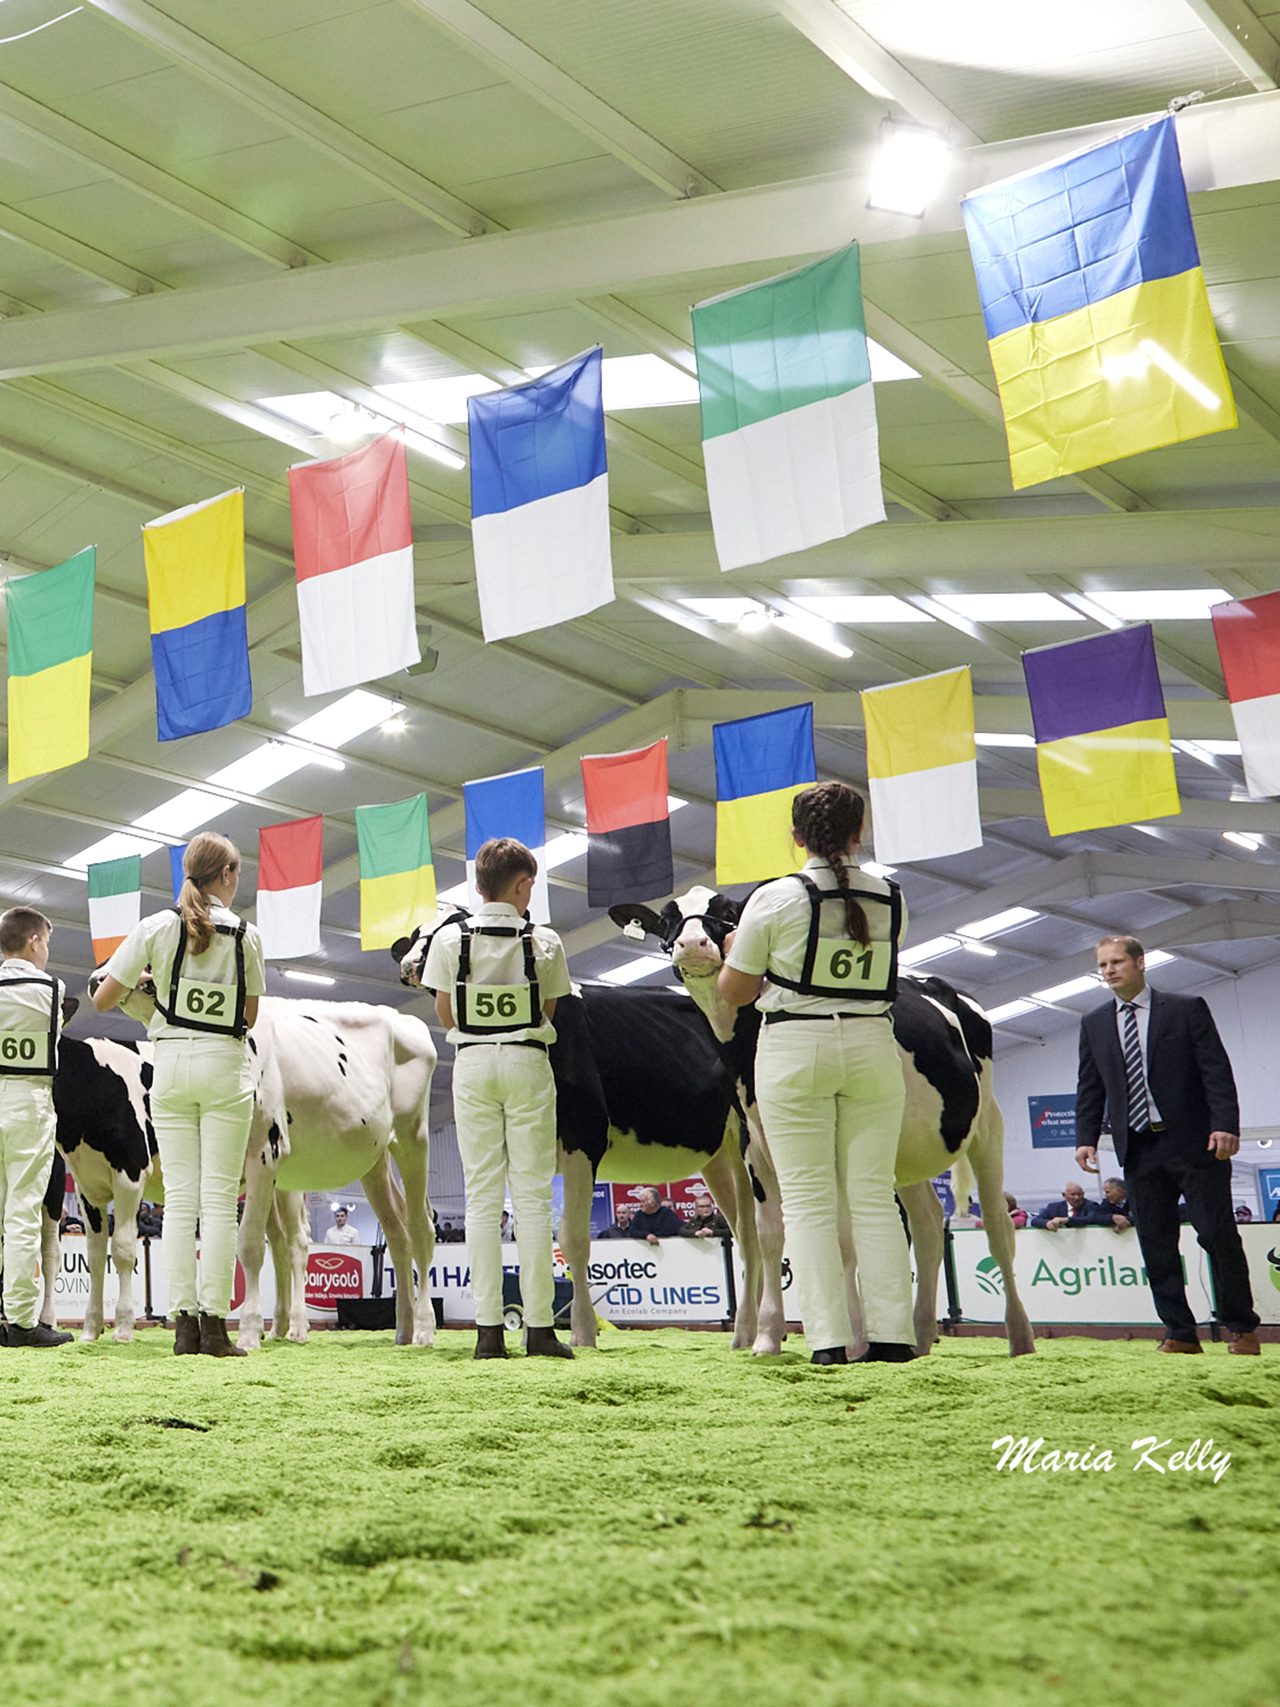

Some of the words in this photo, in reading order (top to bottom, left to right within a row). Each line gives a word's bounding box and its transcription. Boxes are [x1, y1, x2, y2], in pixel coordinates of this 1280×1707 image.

[829, 949, 873, 980] 61
[186, 987, 226, 1017] 62
[475, 992, 517, 1017] 56
[1, 1037, 36, 1060] 60
[676, 1202, 696, 1210] FRO
[1031, 1255, 1189, 1296] Agrila
[606, 1287, 642, 1306] CID
[650, 1286, 720, 1306] LINES
[650, 1308, 687, 1316] Company
